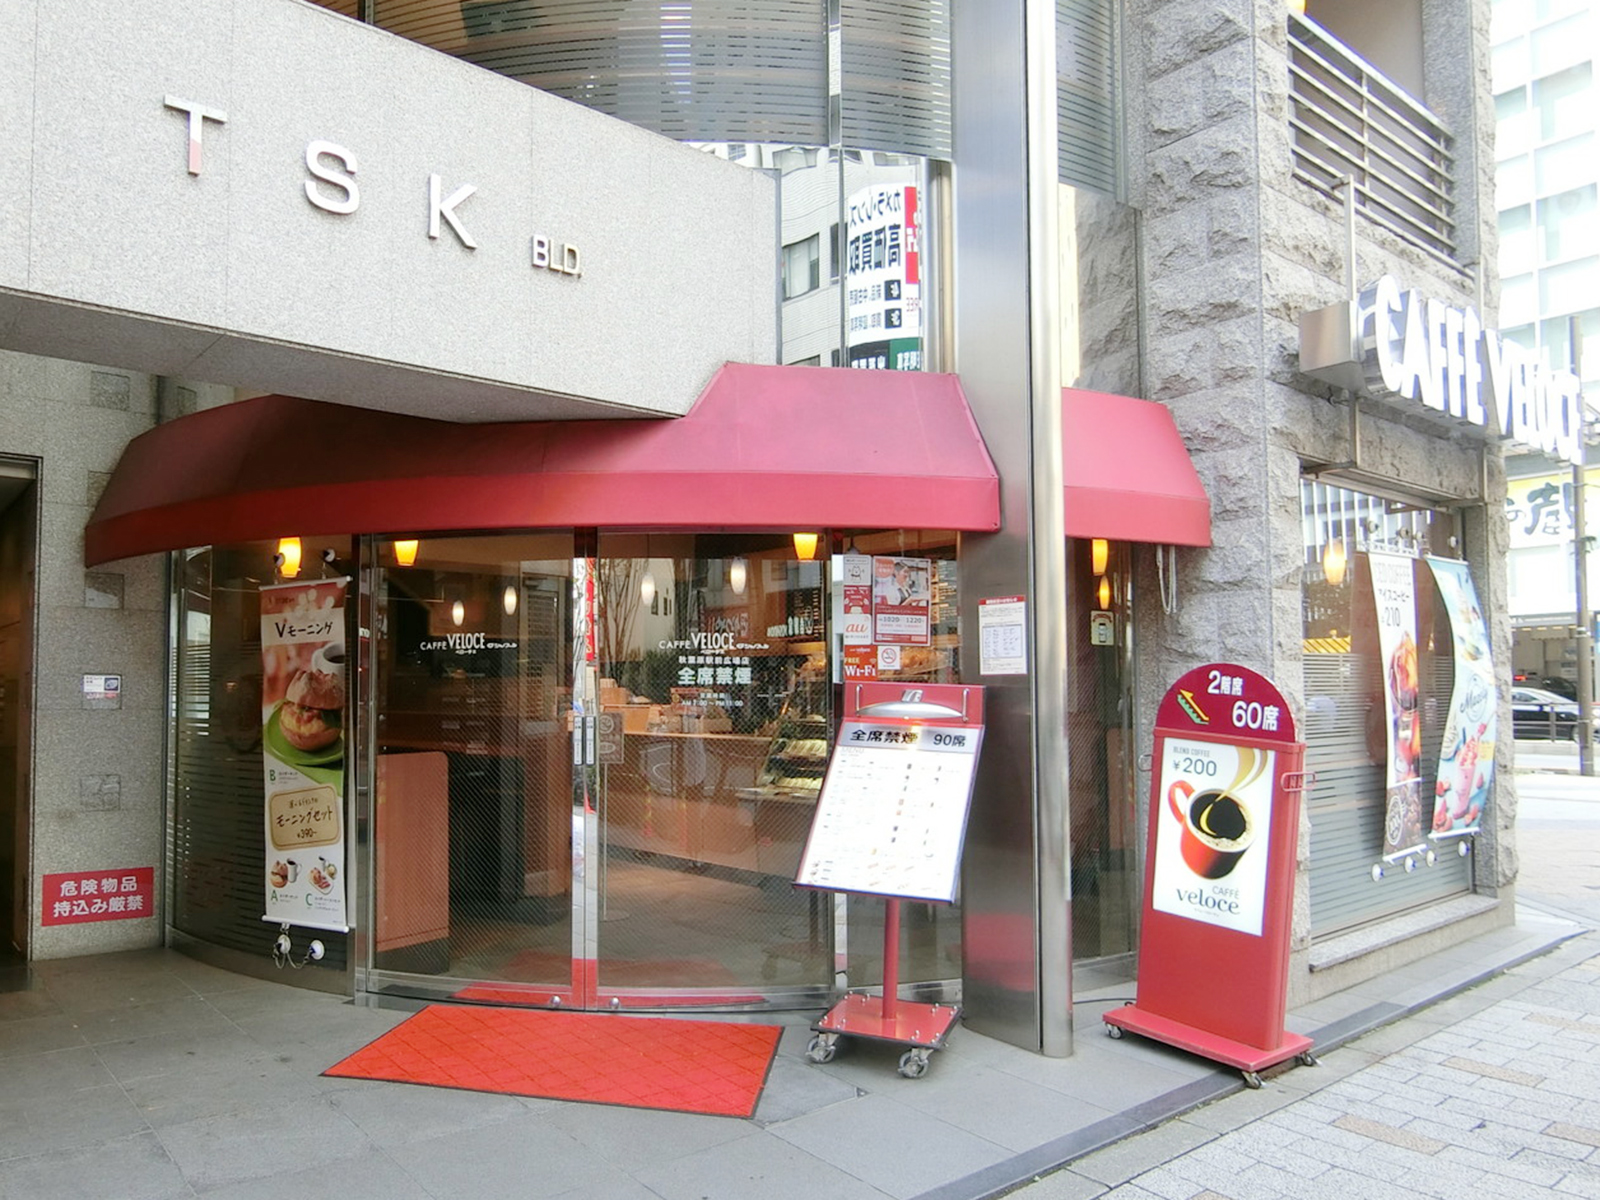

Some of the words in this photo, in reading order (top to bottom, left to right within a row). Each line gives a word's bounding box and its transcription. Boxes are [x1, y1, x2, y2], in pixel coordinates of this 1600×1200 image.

[845, 623, 868, 633] au
[446, 632, 486, 650] VELOCE
[690, 631, 735, 650] VELOCE
[677, 666, 752, 685] 全席禁煙
[844, 664, 877, 677] Wi-Fi
[1207, 670, 1244, 696] 2階席
[1231, 701, 1280, 732] 60席
[850, 729, 919, 745] 全席禁煙
[932, 733, 967, 748] 90席
[1190, 747, 1211, 758] COFFEE
[269, 769, 277, 782] B
[1172, 757, 1217, 777] ¥200
[60, 876, 138, 897] 危険物品
[271, 889, 278, 902] A
[53, 895, 144, 918] 持込み厳禁
[305, 893, 313, 906] C
[1176, 888, 1241, 915] veloce
